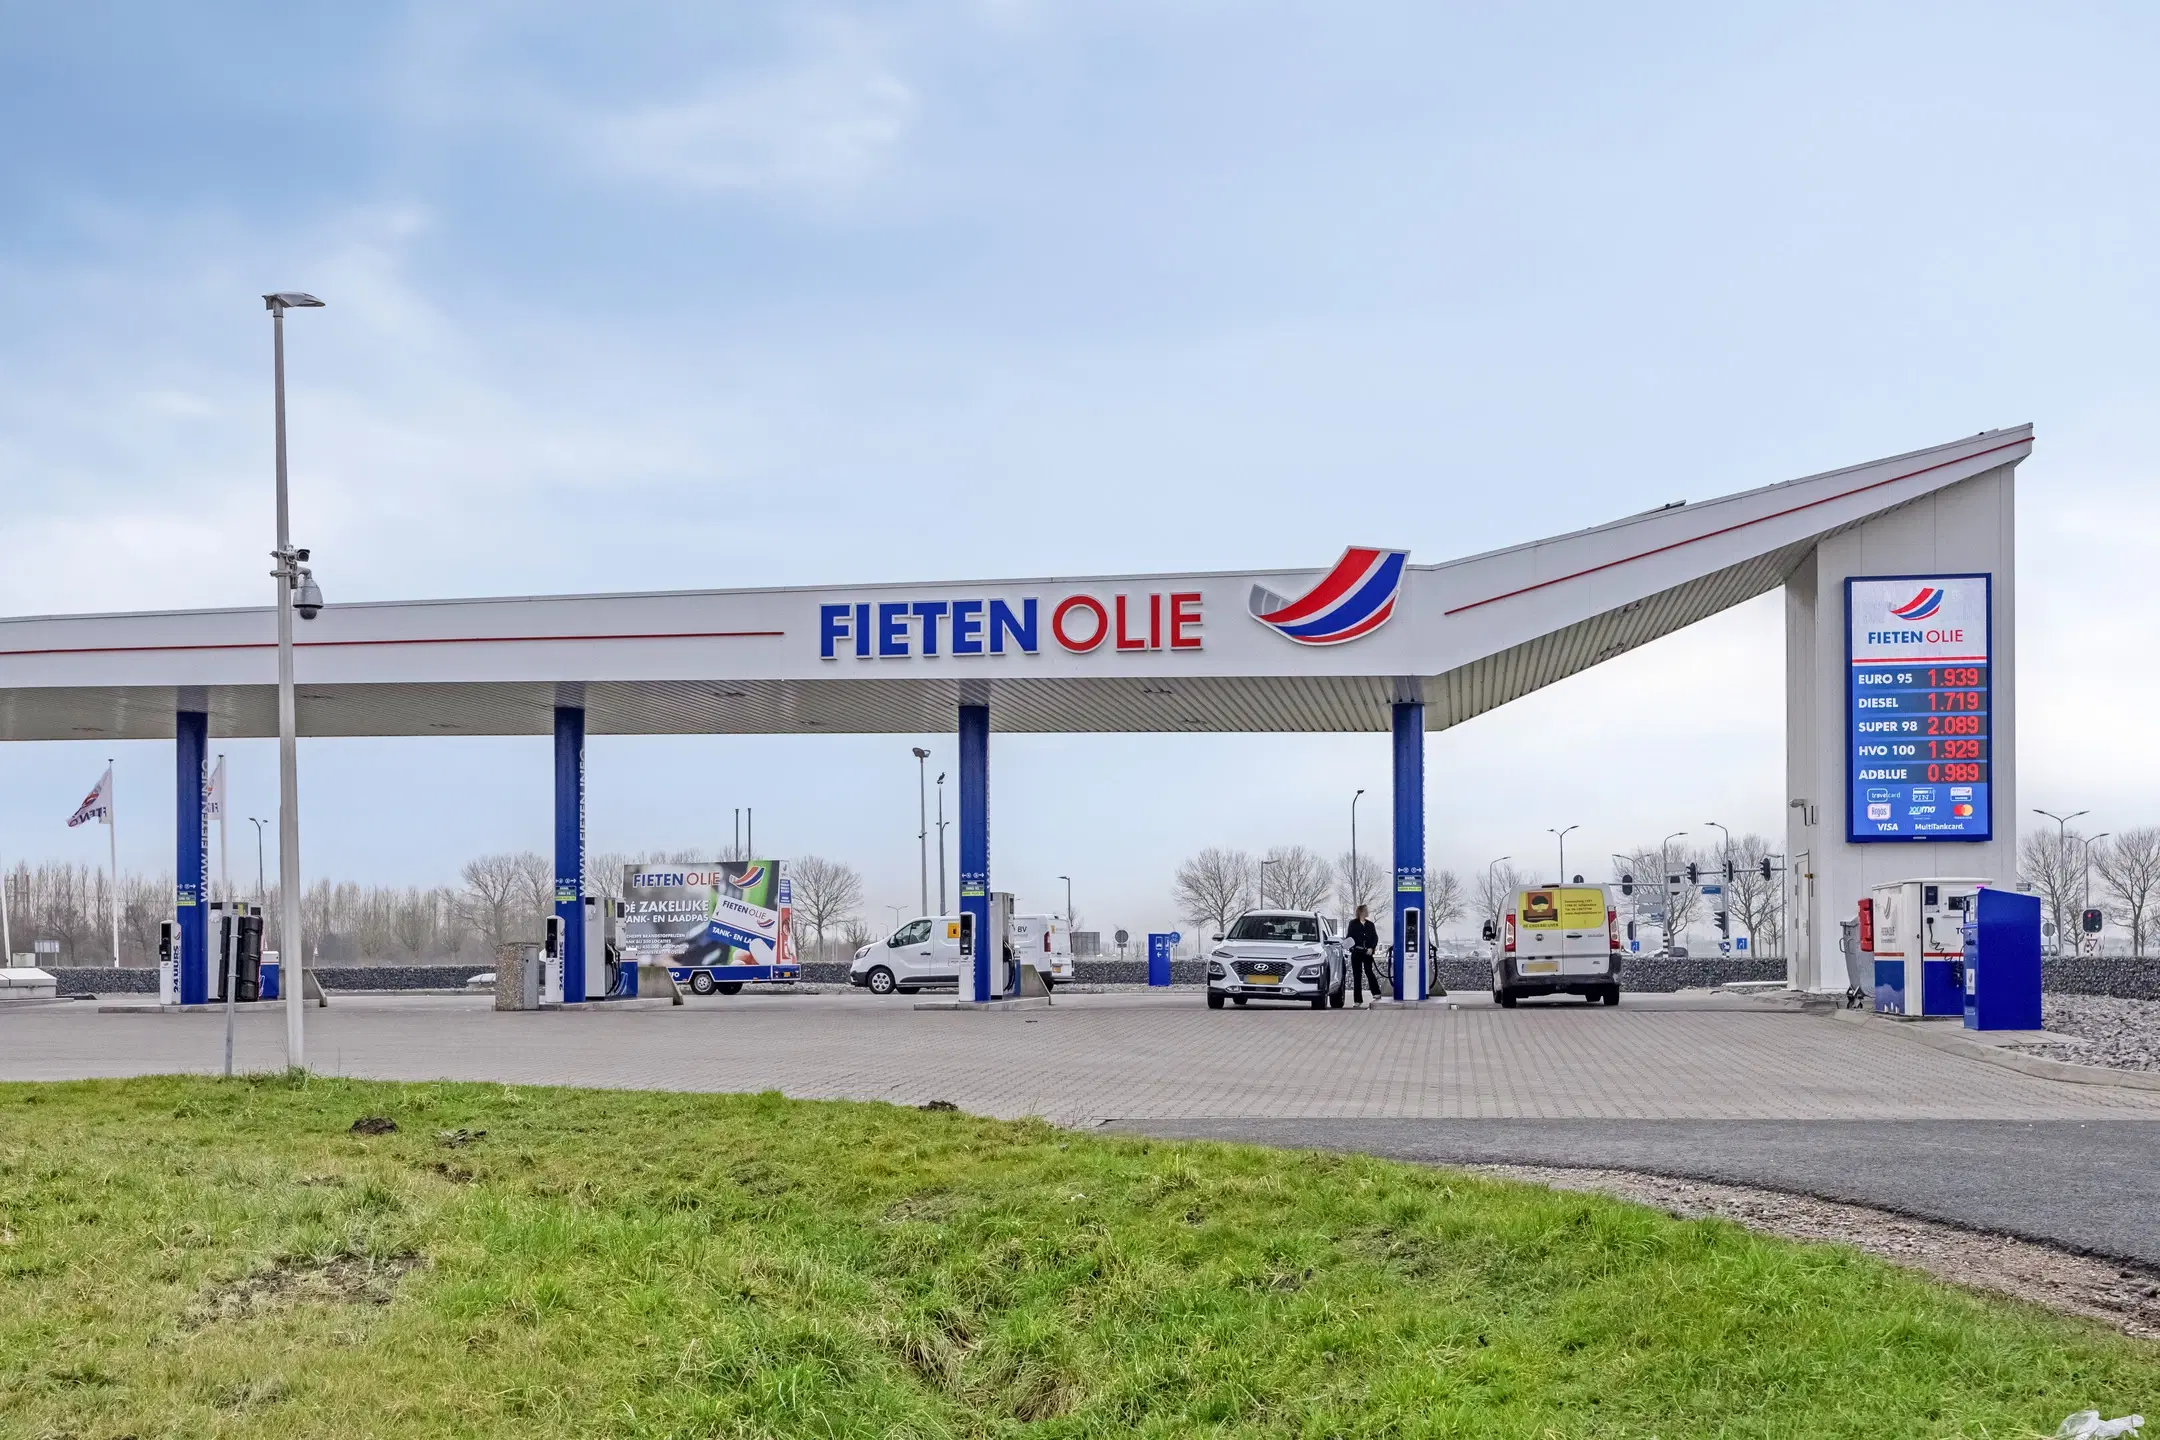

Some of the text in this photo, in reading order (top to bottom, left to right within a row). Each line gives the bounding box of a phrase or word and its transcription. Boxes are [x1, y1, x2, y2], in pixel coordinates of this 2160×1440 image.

[820, 592, 1203, 660] FIETEN OLIE
[1868, 630, 1963, 644] FIETEN OLIE
[1858, 668, 1978, 687] EURO 95 1.939
[1859, 692, 1978, 711] DIESEL 1.719
[1859, 716, 1979, 735] SUPER 98 2.089
[1859, 740, 1979, 758] HVO 100 1.929
[1859, 764, 1979, 782] ADBLUE 0.989
[1872, 791, 1901, 799] travelcard
[1877, 823, 1899, 831] VISA
[633, 872, 721, 888] FIETEN OLIE
[639, 900, 709, 913] ZAKELIJKE
[722, 900, 767, 919] FIETEN OLIE
[626, 914, 709, 923] ANK- EN LAADPAS
[712, 927, 732, 937] TANK-
